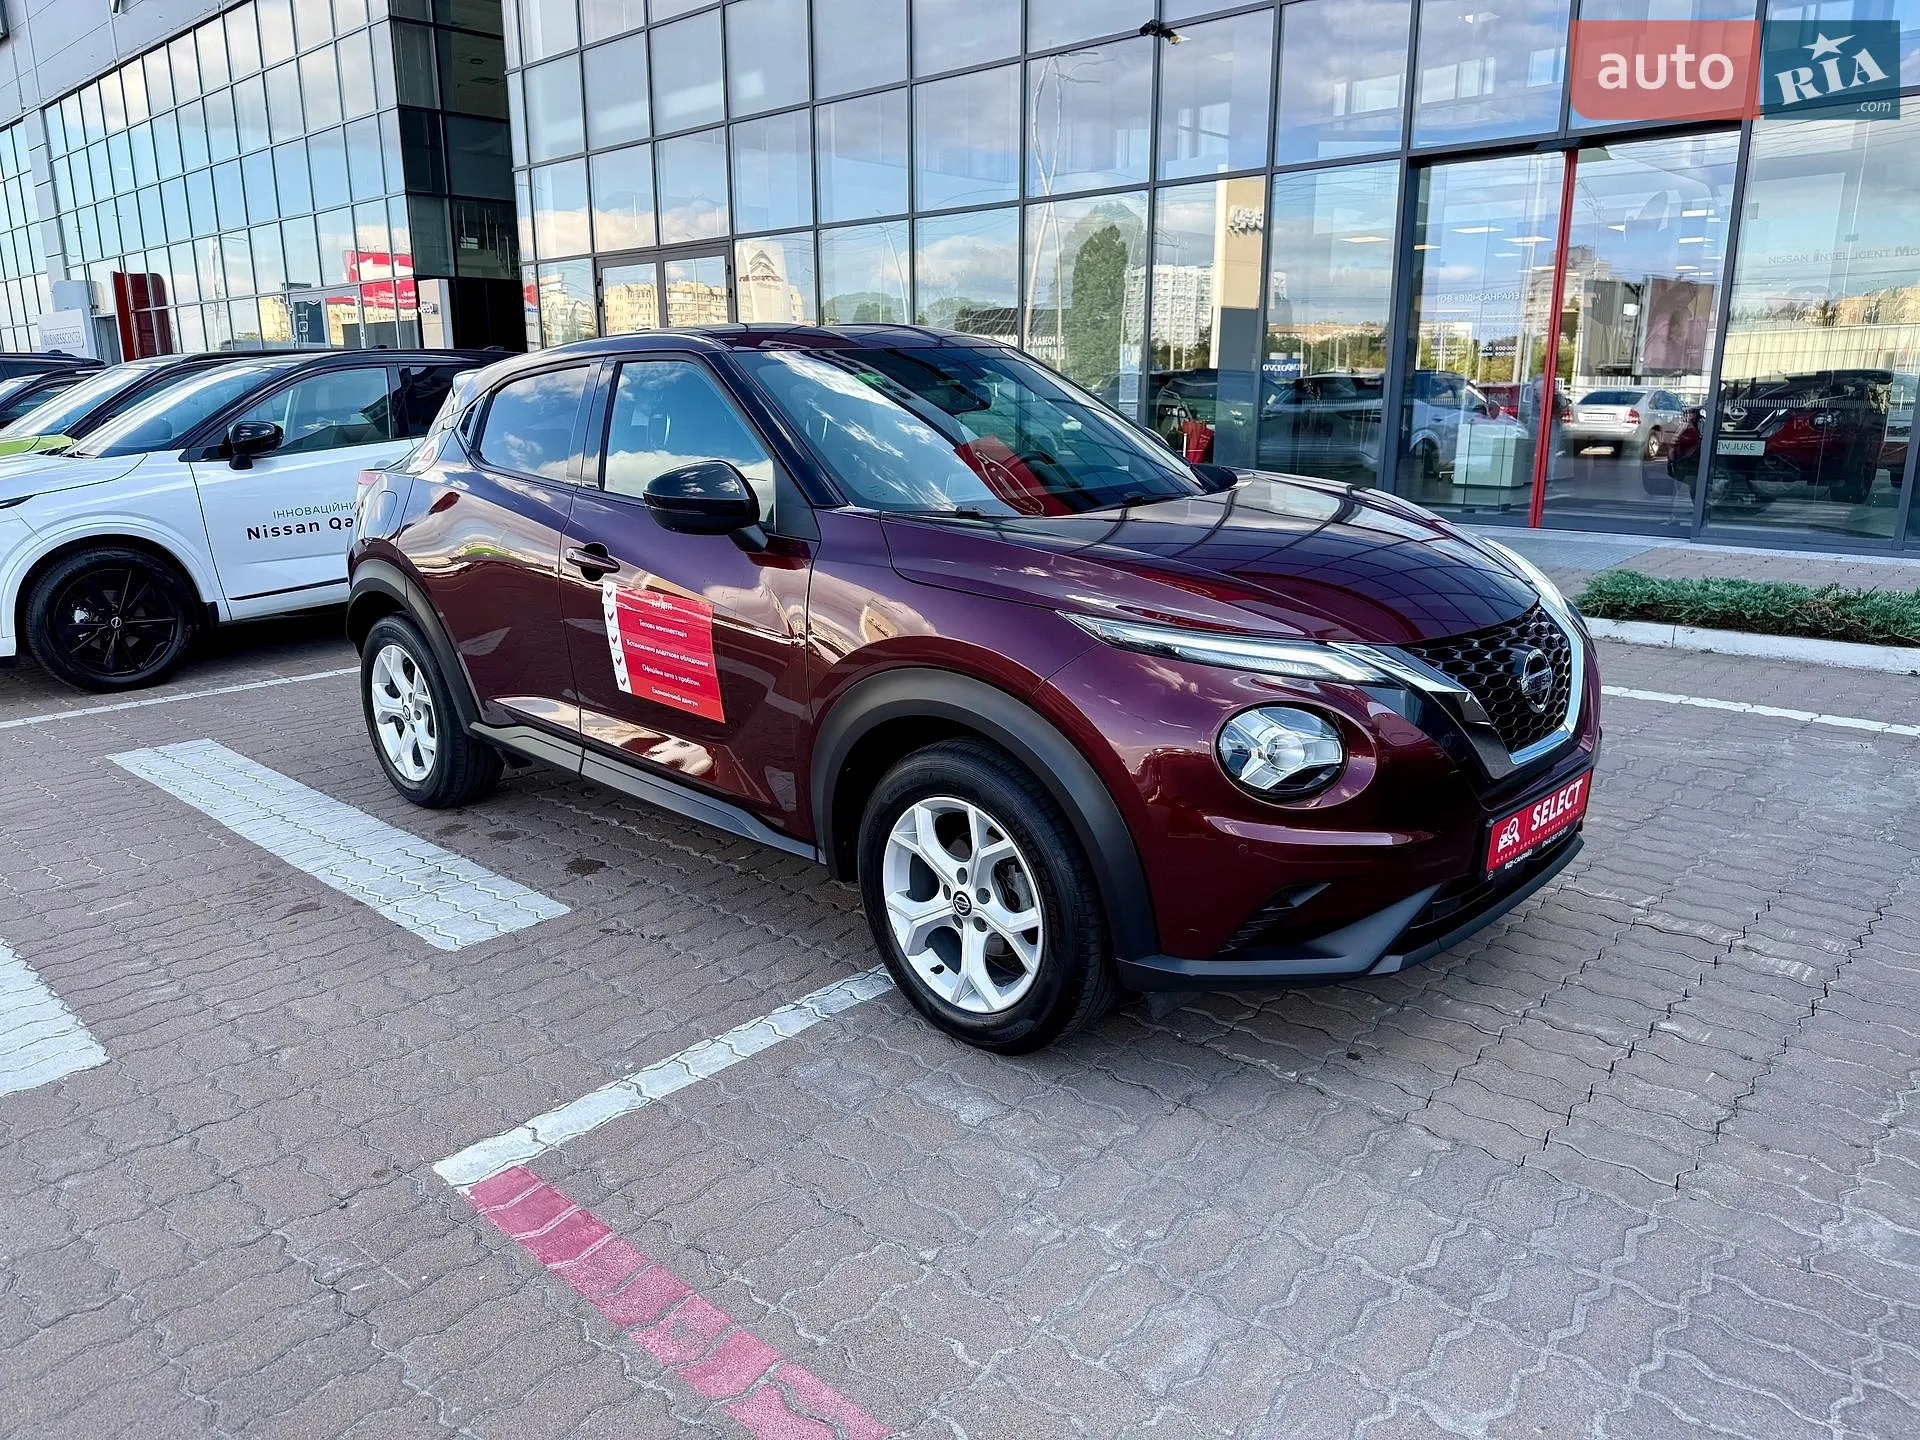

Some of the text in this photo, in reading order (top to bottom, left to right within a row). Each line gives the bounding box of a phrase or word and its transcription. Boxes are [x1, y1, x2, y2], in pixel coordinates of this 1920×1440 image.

[1768, 255, 1808, 265] NISSAN
[1733, 442, 1756, 451] JUKE
[246, 521, 321, 541] Nissan
[1530, 778, 1584, 832] SELECT
